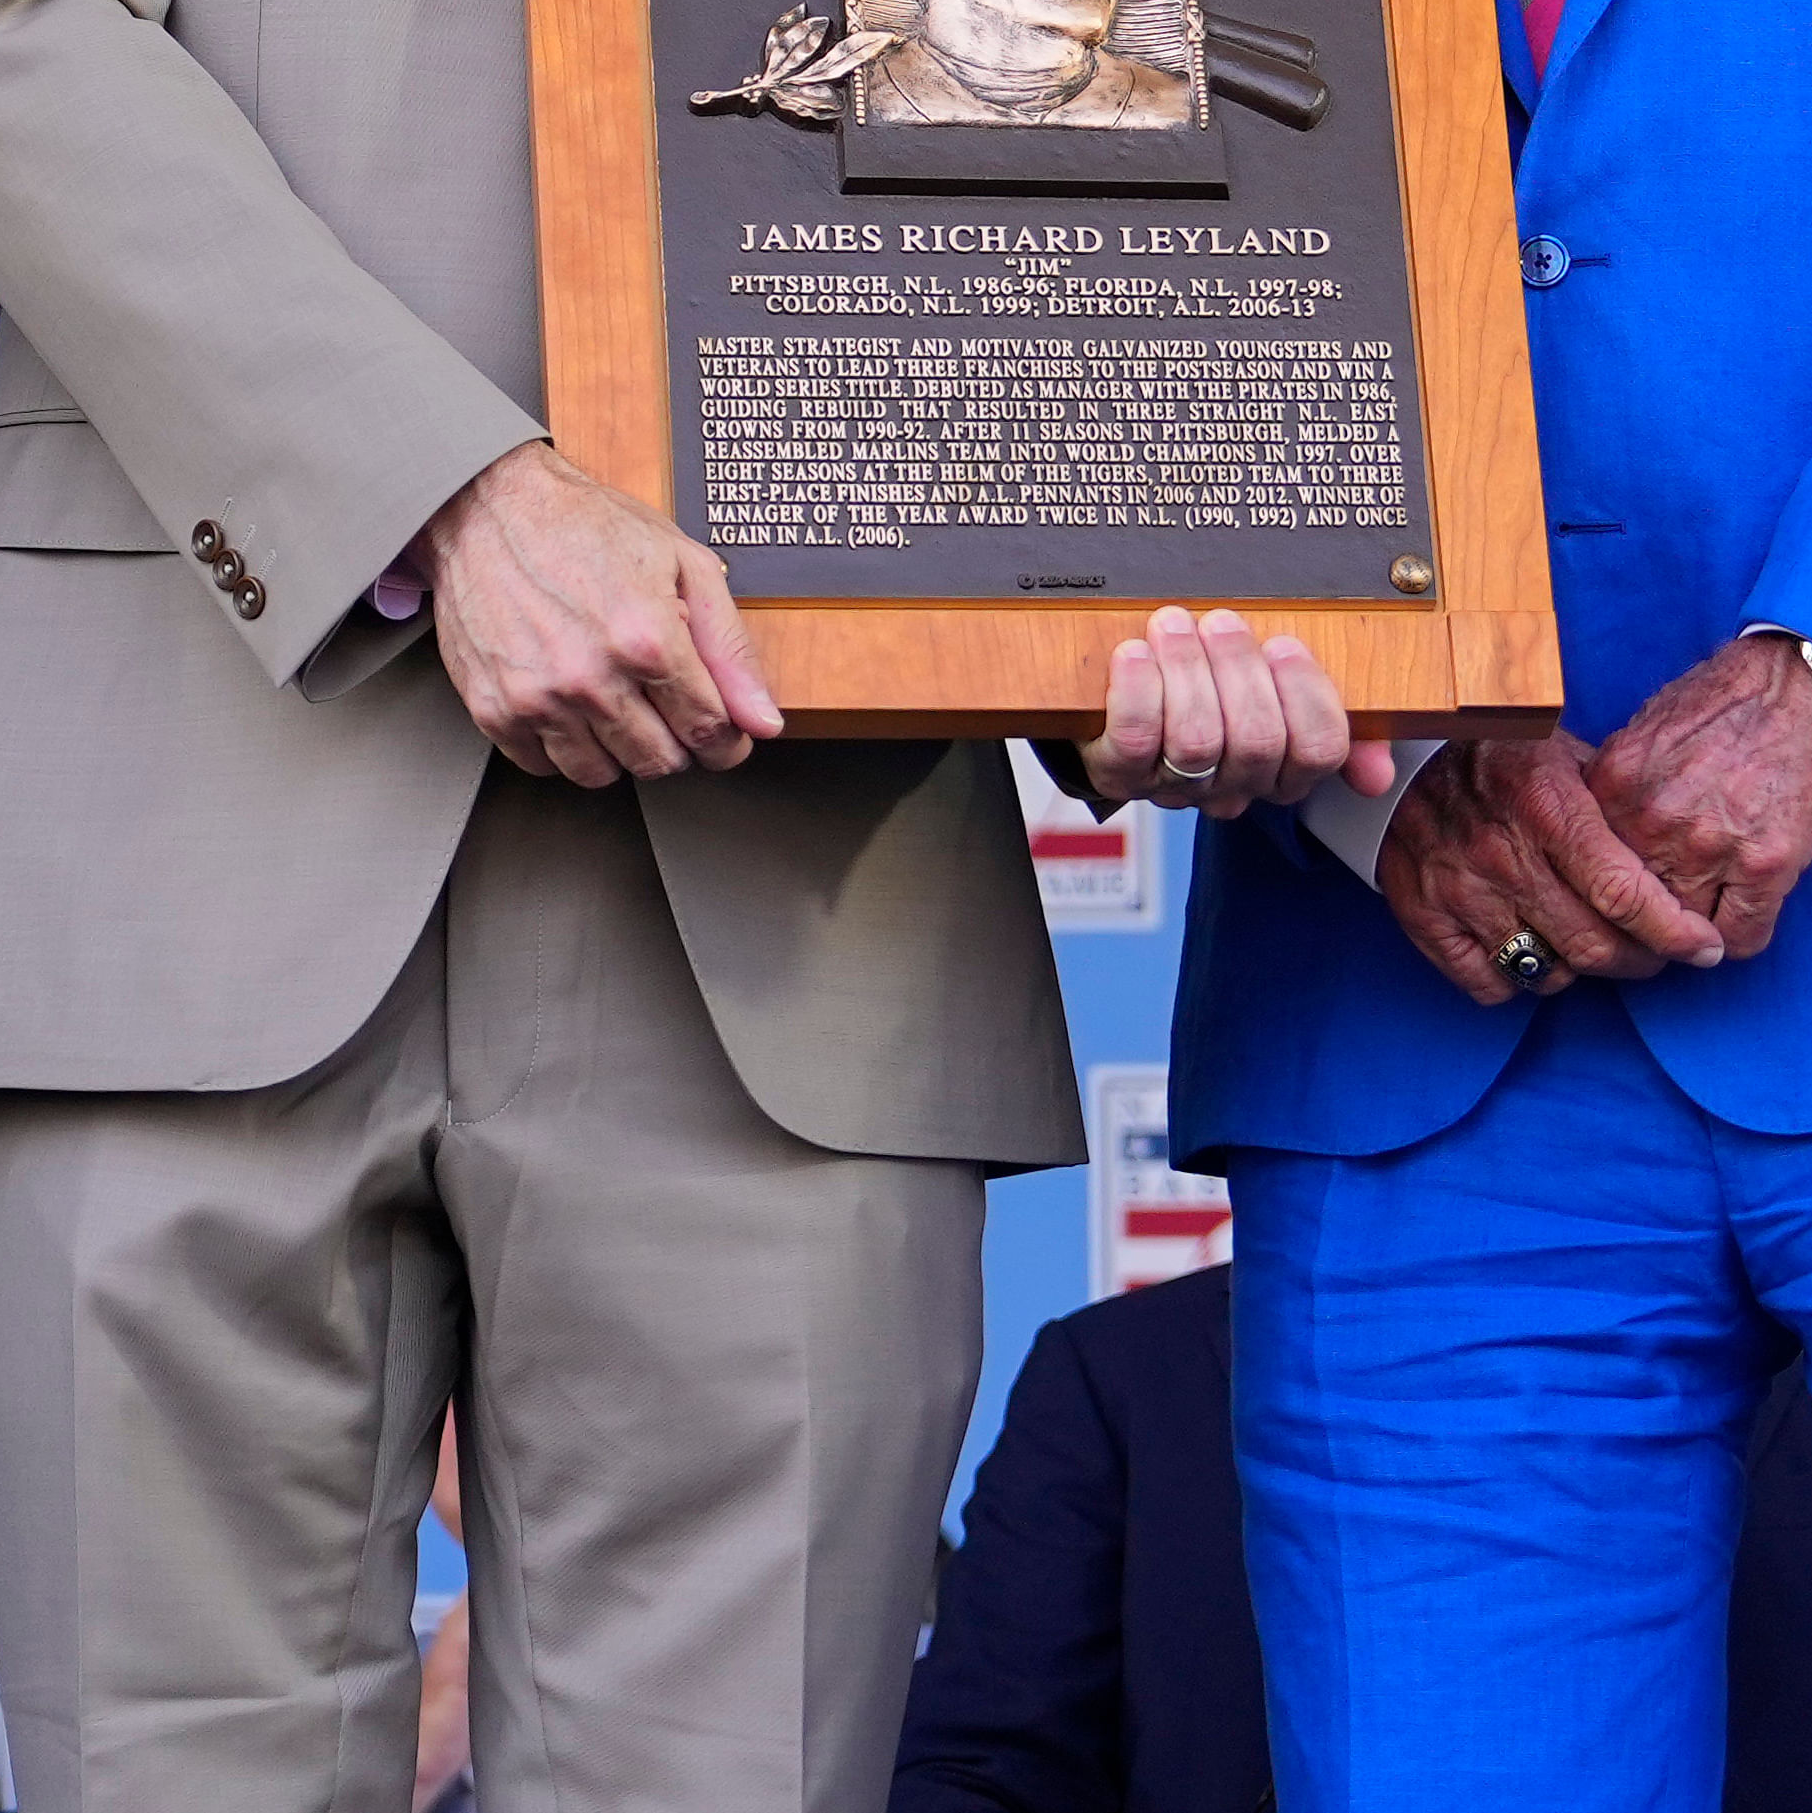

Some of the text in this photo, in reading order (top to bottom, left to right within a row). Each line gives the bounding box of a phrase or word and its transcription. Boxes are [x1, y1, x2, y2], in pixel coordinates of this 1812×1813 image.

[740, 223, 1331, 255] JAMES RICHARD LEYLAND
[1004, 256, 1072, 276] “JIM”
[730, 275, 1343, 300] PITTSBURGH, N.L. 1986-96; FLORIDA, N.L. 1997-98;
[765, 294, 1316, 319] COLORADO, N.L. 1999; DETROIT, A.L. 2006-13
[698, 336, 1393, 360] MASTER STRATEGIST AND MOTIVATOR GALVANIZED YOUNGSTERS AND
[699, 357, 1395, 380] VETERANS TO LEAD THREE FRANCHISES TO THE POSTSEASON AND WIN A
[700, 378, 1397, 404] WORLD SERIES TITLE. DEBUTED AS MANAGER WITH THE PIRATES IN 1986,
[701, 398, 1398, 422] GUIDING REBUILD THAT RESULTED IN THREE STRAIGHT N.L. EAST
[702, 419, 1400, 445] CROWNS FROM 1990-92. AFTER 11 SEASONS IN PITTSBURGH, MELDED A
[704, 440, 1403, 463] REASSEMBLED MARLINS TEAM INTO WORLD CHAMPIONS IN 1997. OVER
[705, 461, 1404, 486] EIGHT SEASONS AT THE HELM OF THE TIGERS, PILOTED TEAM TO THREE
[707, 482, 1406, 505] FIRST-PLACE FINISHES AND A.L. PENNANTS IN 2006 AND 2012. WINNER OF
[708, 503, 1409, 530] MANAGER OF THE YEAR AWARD TWICE IN N.L. (1990, 1992) AND ONCE
[710, 525, 911, 549] AGAIN IN A.L. (2006).
